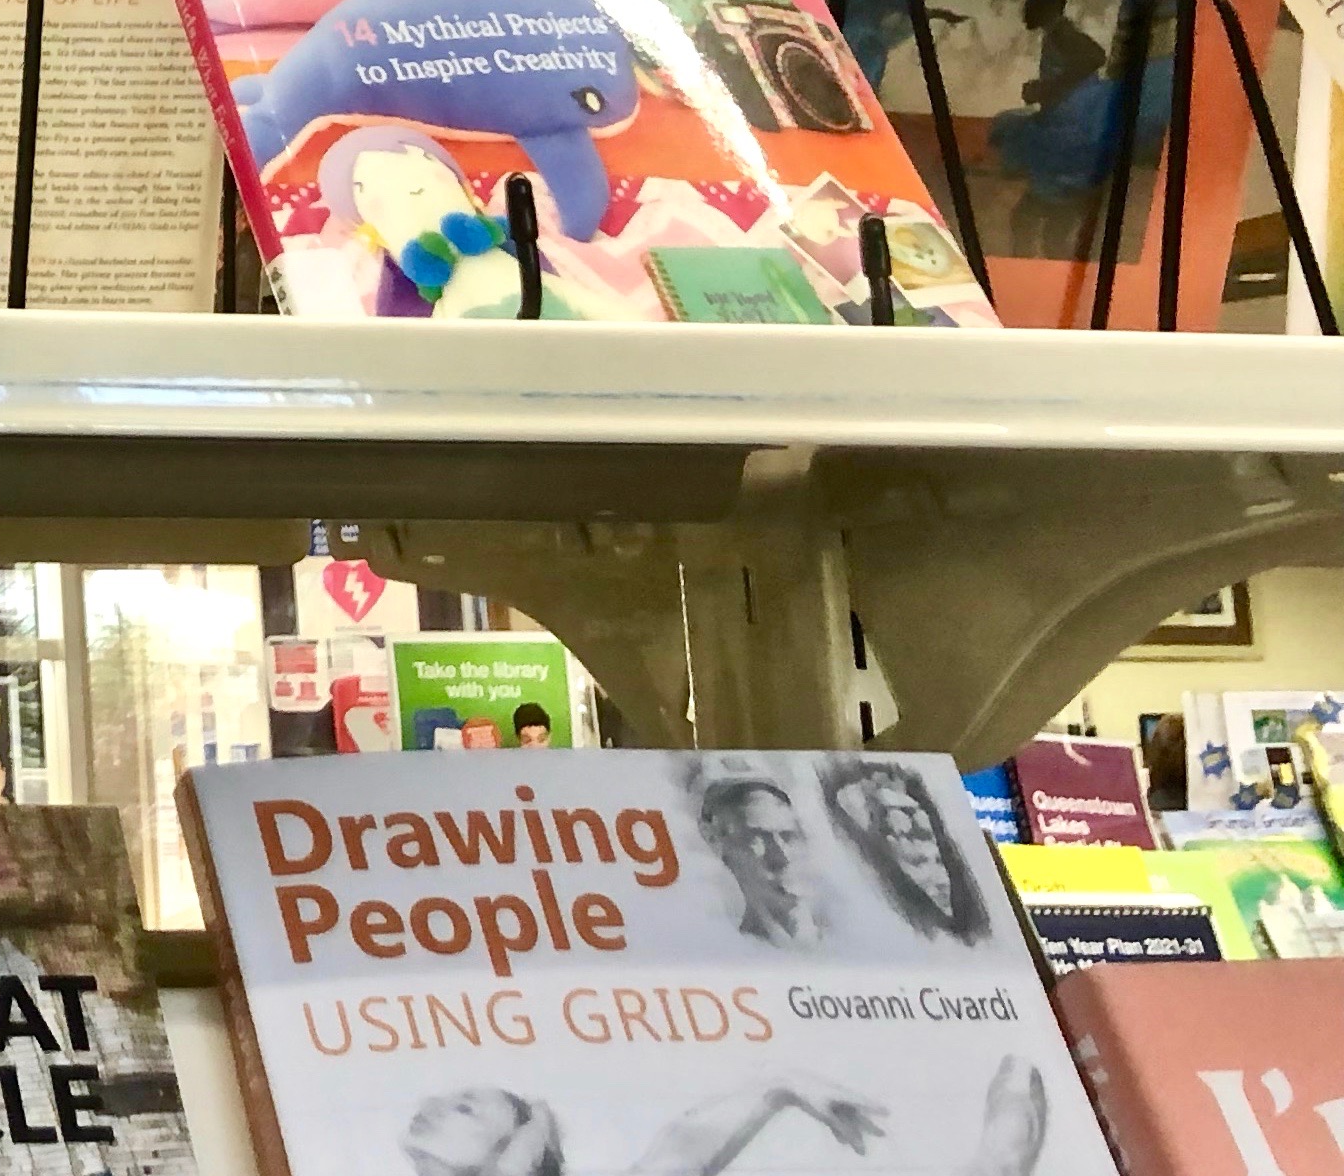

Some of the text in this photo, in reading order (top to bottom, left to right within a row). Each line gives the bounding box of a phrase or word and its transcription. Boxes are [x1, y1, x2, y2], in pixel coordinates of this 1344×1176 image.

[333, 13, 608, 48] 14 Mythical Projects
[354, 45, 619, 87] to Inspire Creativity
[414, 661, 549, 682] Take the library
[445, 682, 521, 702] with you
[252, 784, 679, 888] Drawing
[274, 873, 628, 978] People
[302, 983, 1019, 1056] USING GRIDS Giovanni Civardi
